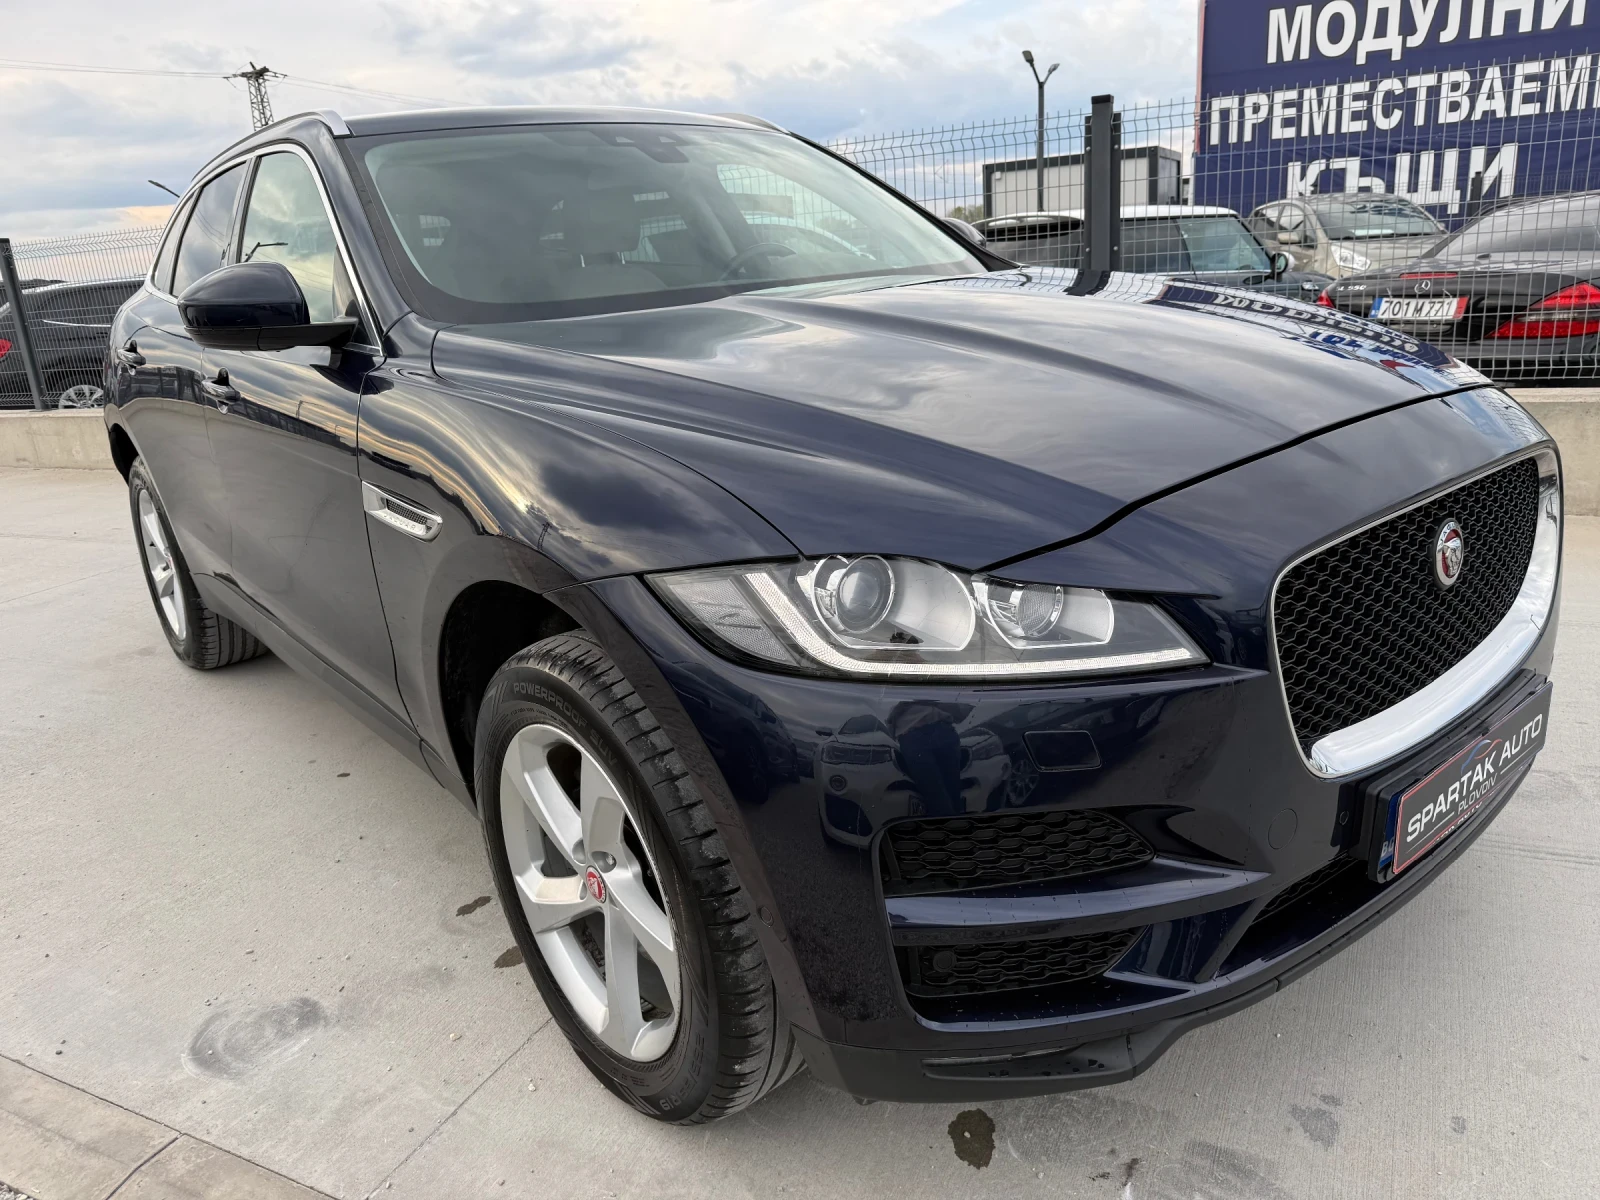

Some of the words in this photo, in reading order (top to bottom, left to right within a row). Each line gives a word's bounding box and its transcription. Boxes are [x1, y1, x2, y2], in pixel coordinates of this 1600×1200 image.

[1209, 54, 1600, 146] ПРЕМЕСТВАЕМ
[1286, 142, 1519, 215] КЪЩИ
[513, 682, 588, 728] POWERPROOF
[589, 729, 618, 765] SUV
[1406, 750, 1497, 843] SPARTAK
[1498, 713, 1543, 767] AUTO
[1457, 772, 1498, 815] PLOVDIV
